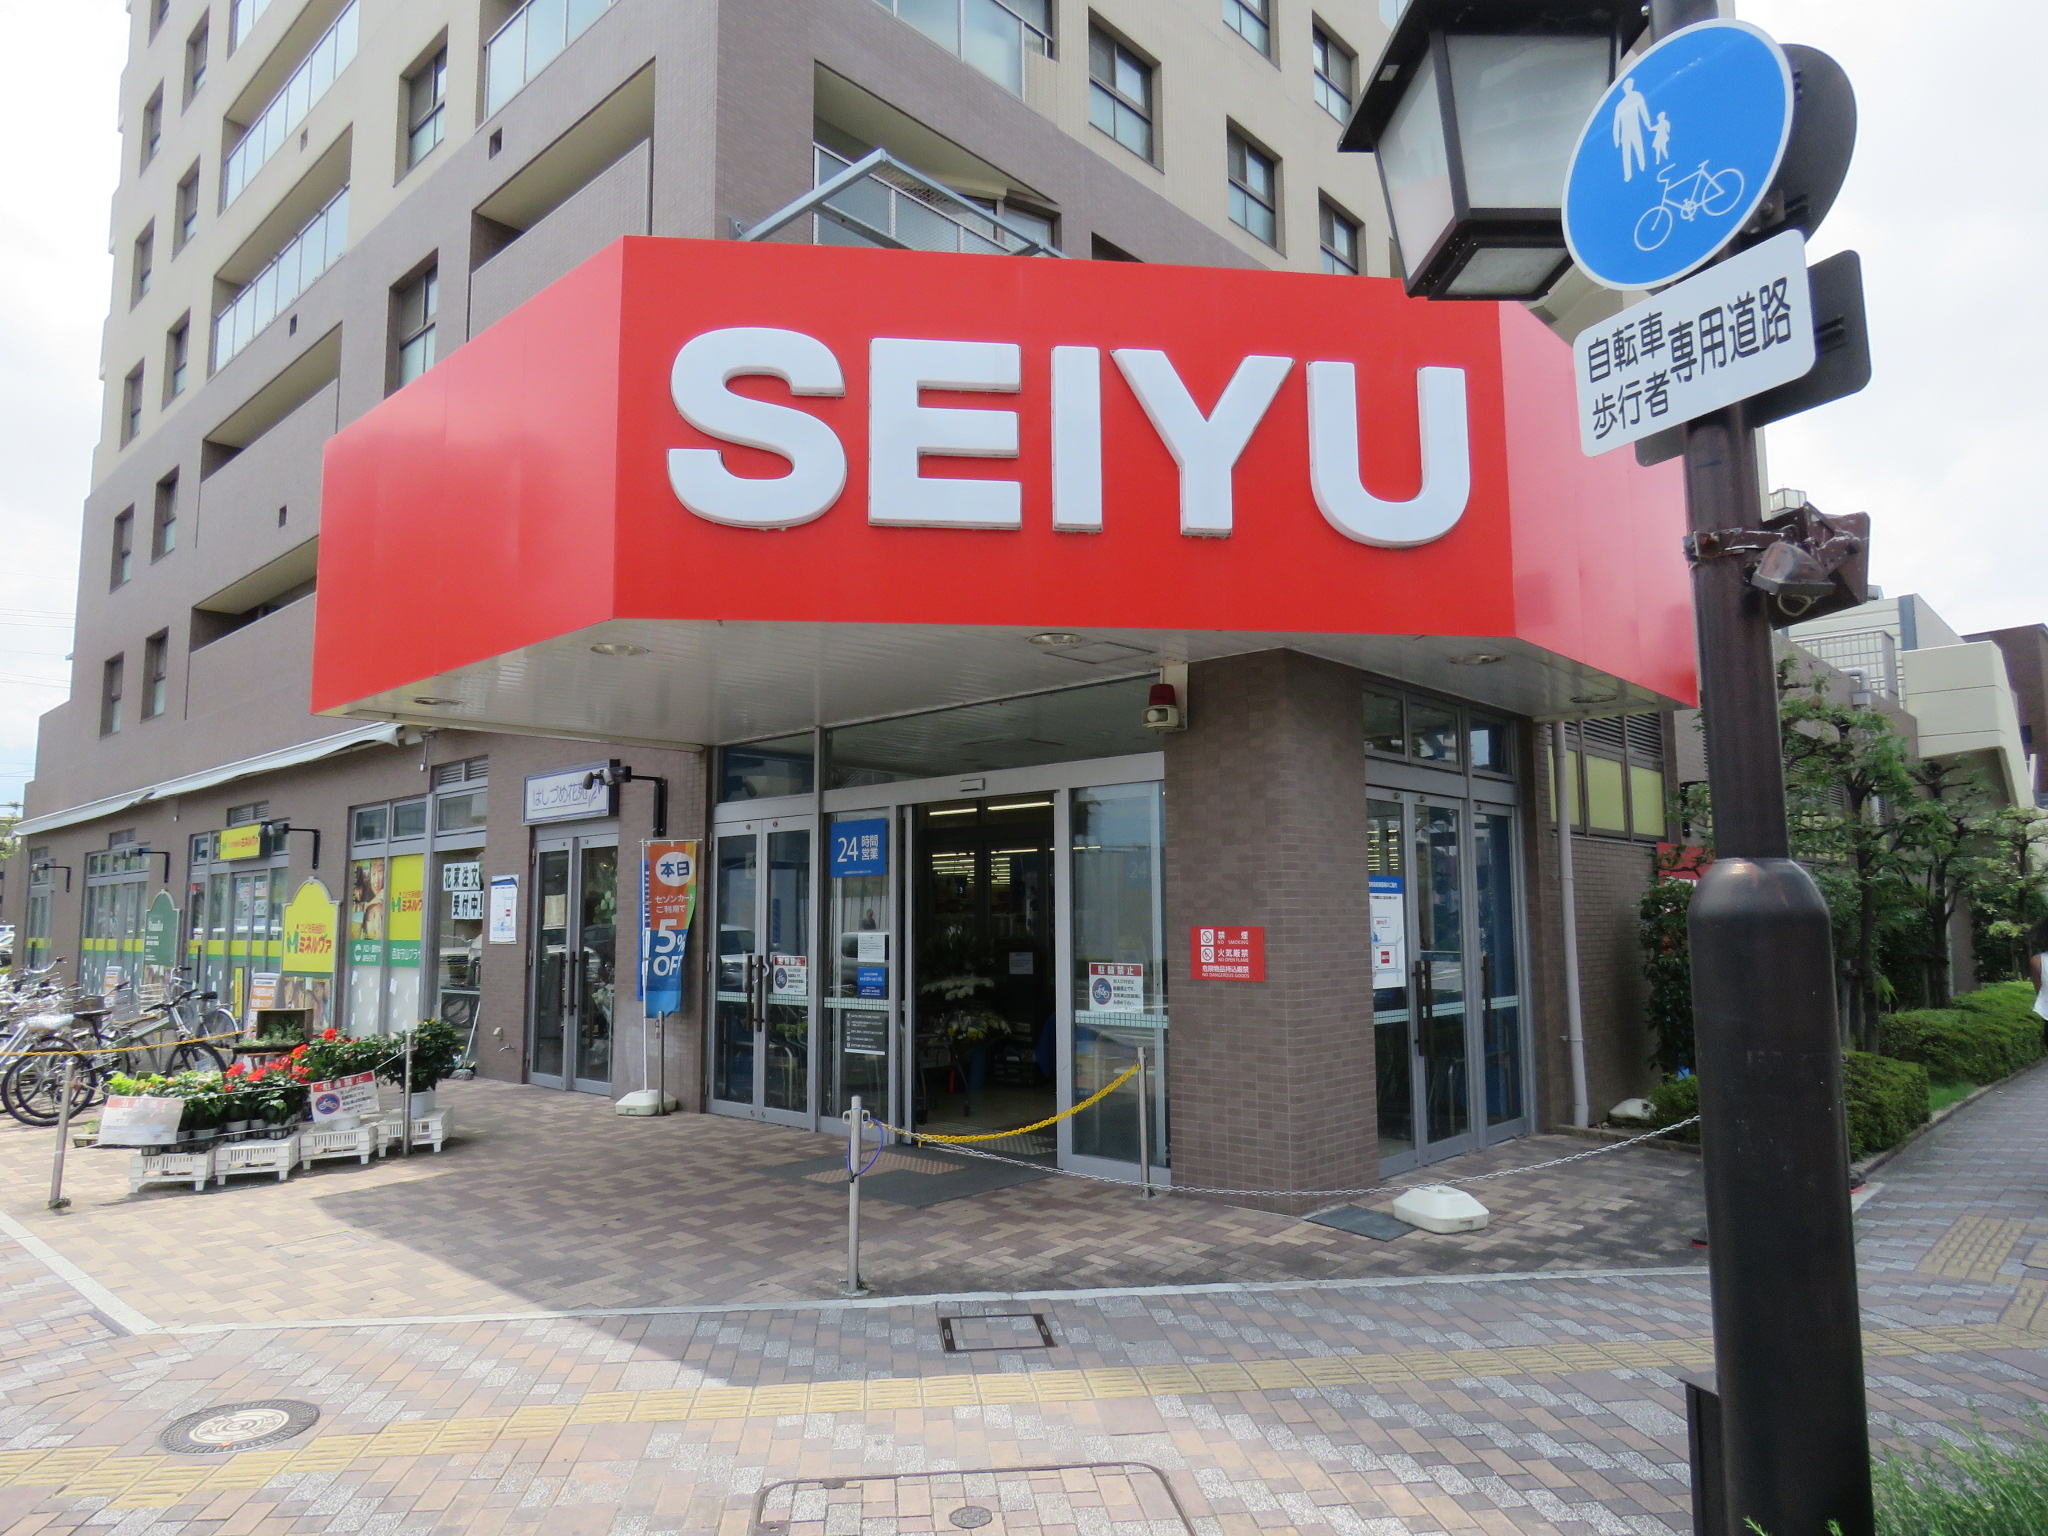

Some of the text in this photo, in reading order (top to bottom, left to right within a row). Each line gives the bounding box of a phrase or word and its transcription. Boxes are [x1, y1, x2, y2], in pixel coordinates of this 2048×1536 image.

[1668, 277, 1791, 384] 専用道路
[1588, 312, 1665, 383] 自転車
[1593, 369, 1670, 440] 歩行者
[667, 327, 1471, 548] SEIYU
[837, 837, 859, 862] 24
[861, 835, 878, 847] 時間
[861, 848, 878, 860] 営業
[445, 865, 478, 888] 花束注文
[660, 861, 690, 878] 本日
[655, 893, 694, 904] セゾンカード
[656, 904, 686, 913] ご利用で
[1218, 949, 1248, 957] 火気厳禁
[1098, 965, 1134, 975] 駐輪禁止
